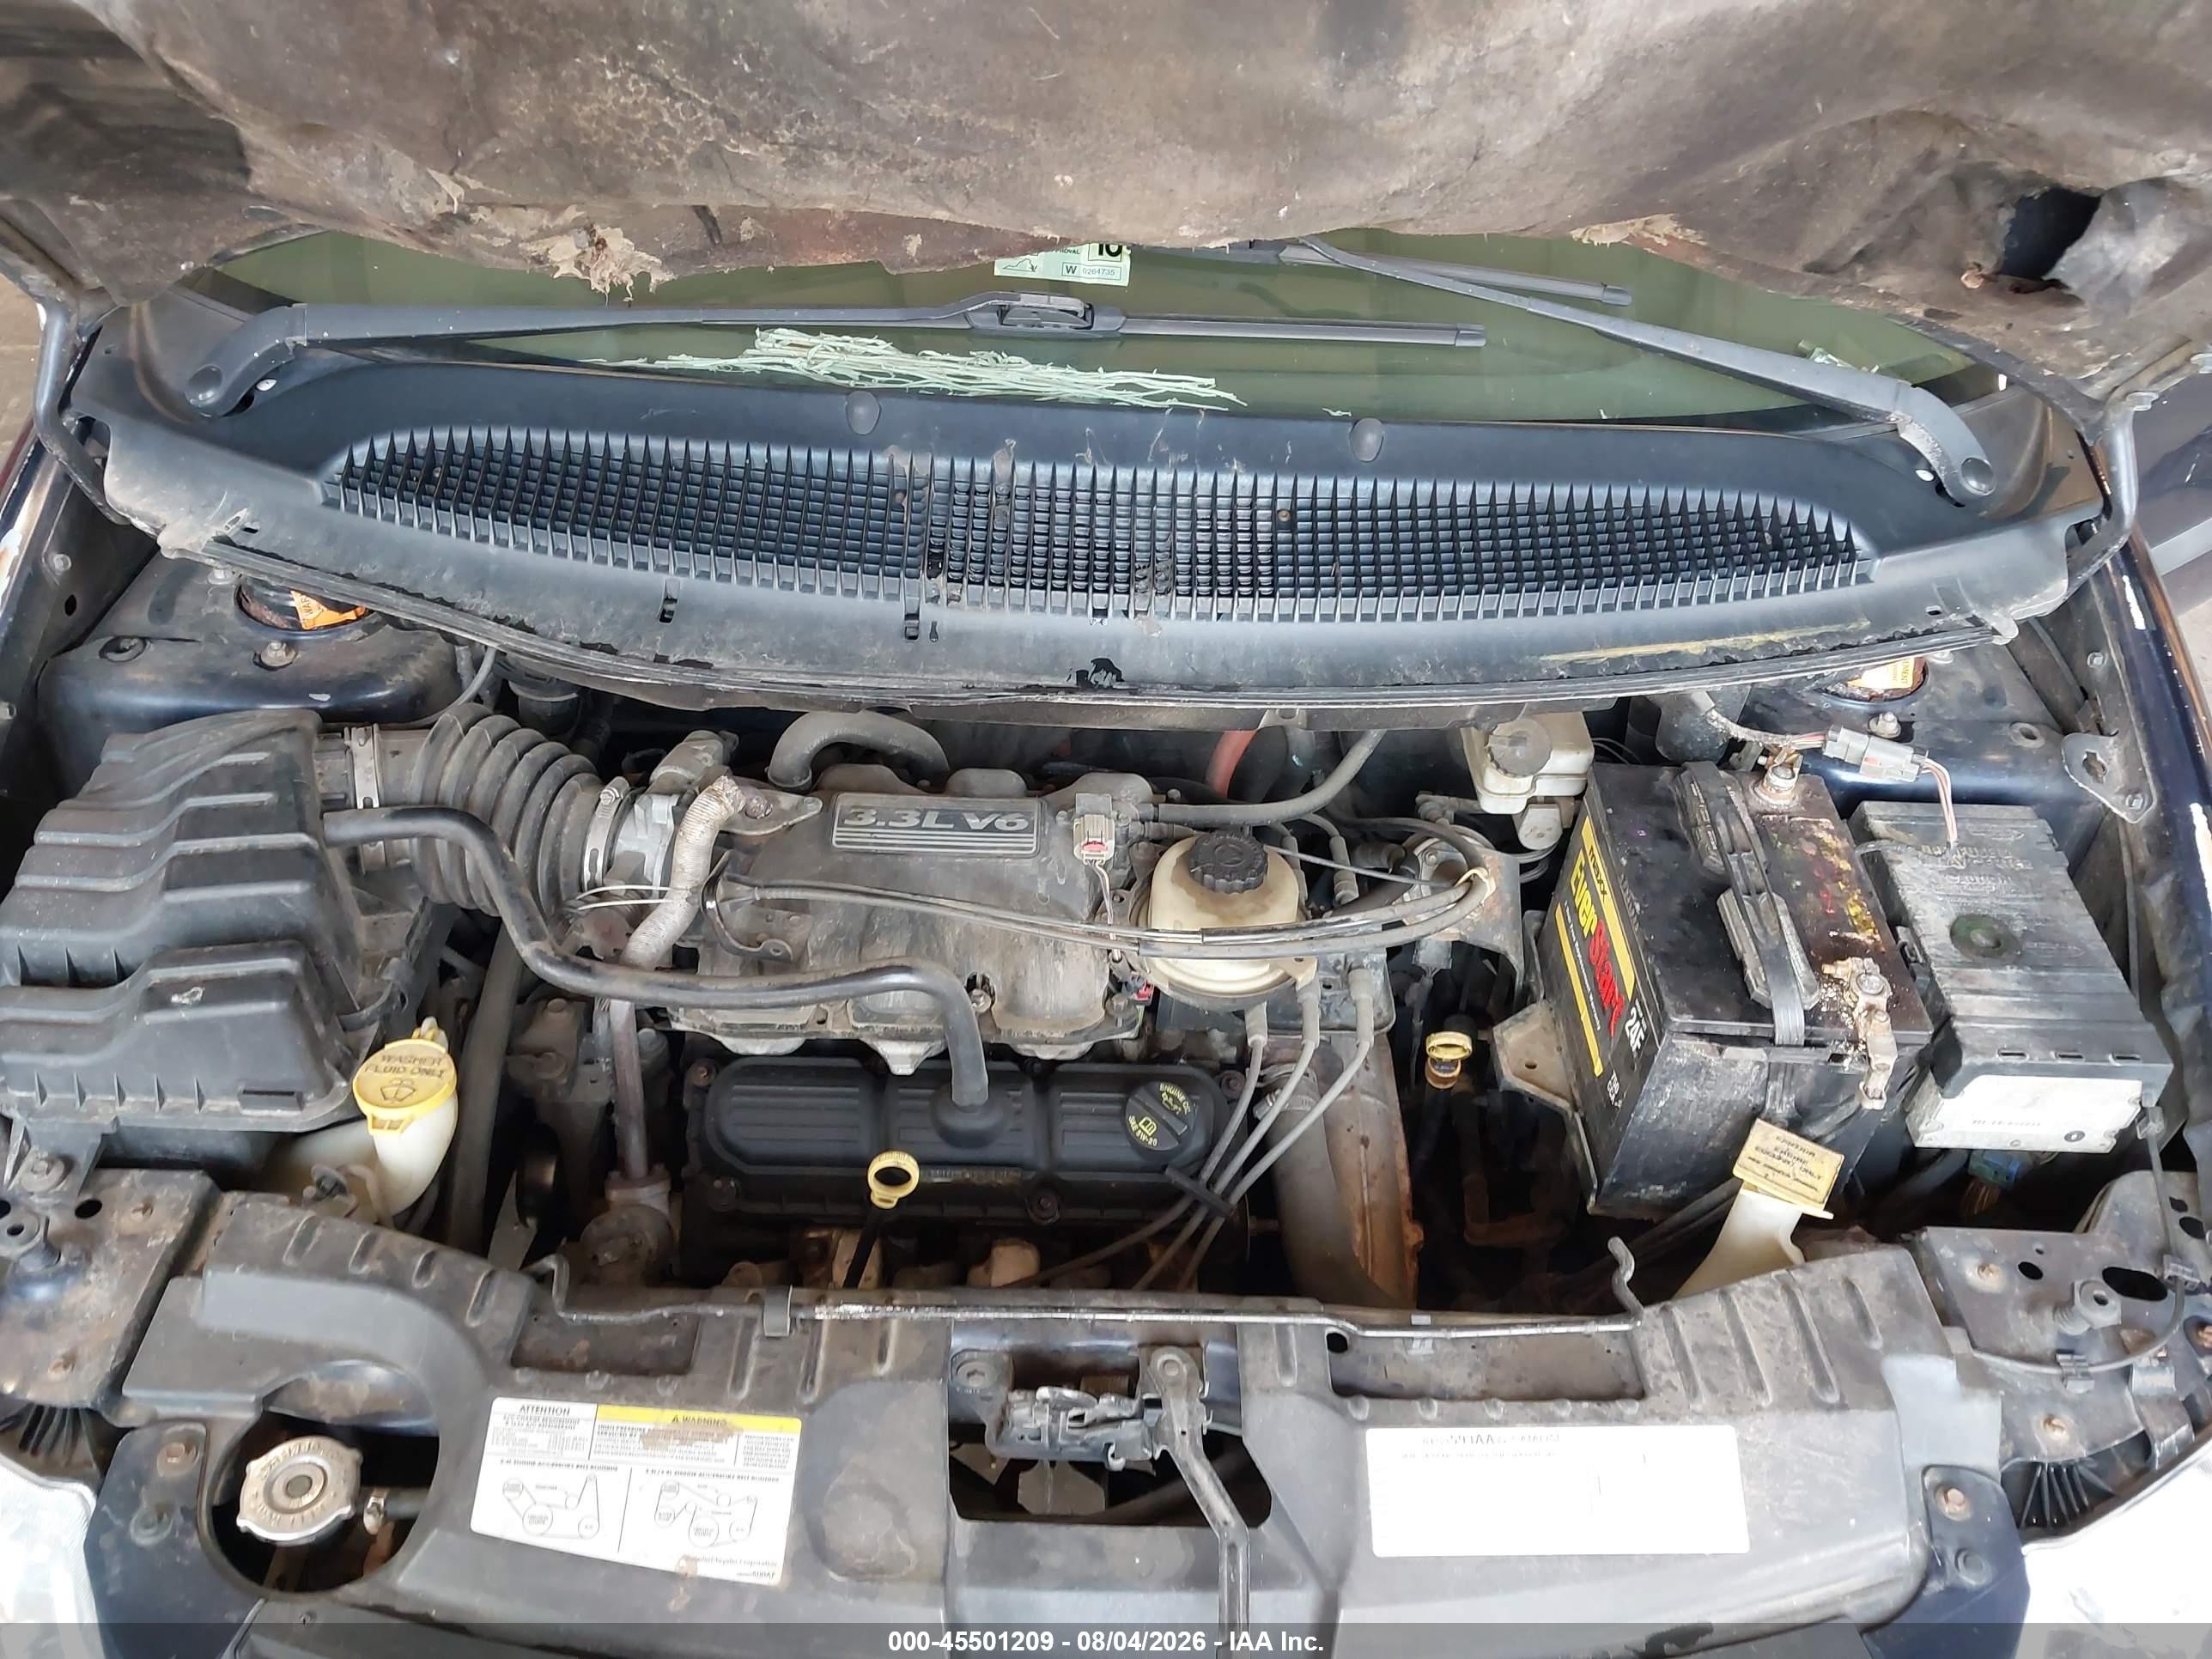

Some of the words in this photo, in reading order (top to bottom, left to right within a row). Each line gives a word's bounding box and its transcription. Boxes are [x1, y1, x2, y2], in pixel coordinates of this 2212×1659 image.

[1066, 265, 1077, 274] W
[843, 808, 954, 829] 3.3L
[962, 811, 1029, 831] V6
[1589, 847, 1607, 902] maxx
[1625, 1006, 1644, 1055] 24F
[380, 1054, 442, 1066] WASHER
[365, 1064, 406, 1074] FLUID
[410, 1066, 447, 1079] ONLY
[520, 1404, 570, 1417] ATTENTION
[683, 1415, 727, 1427] WARNING
